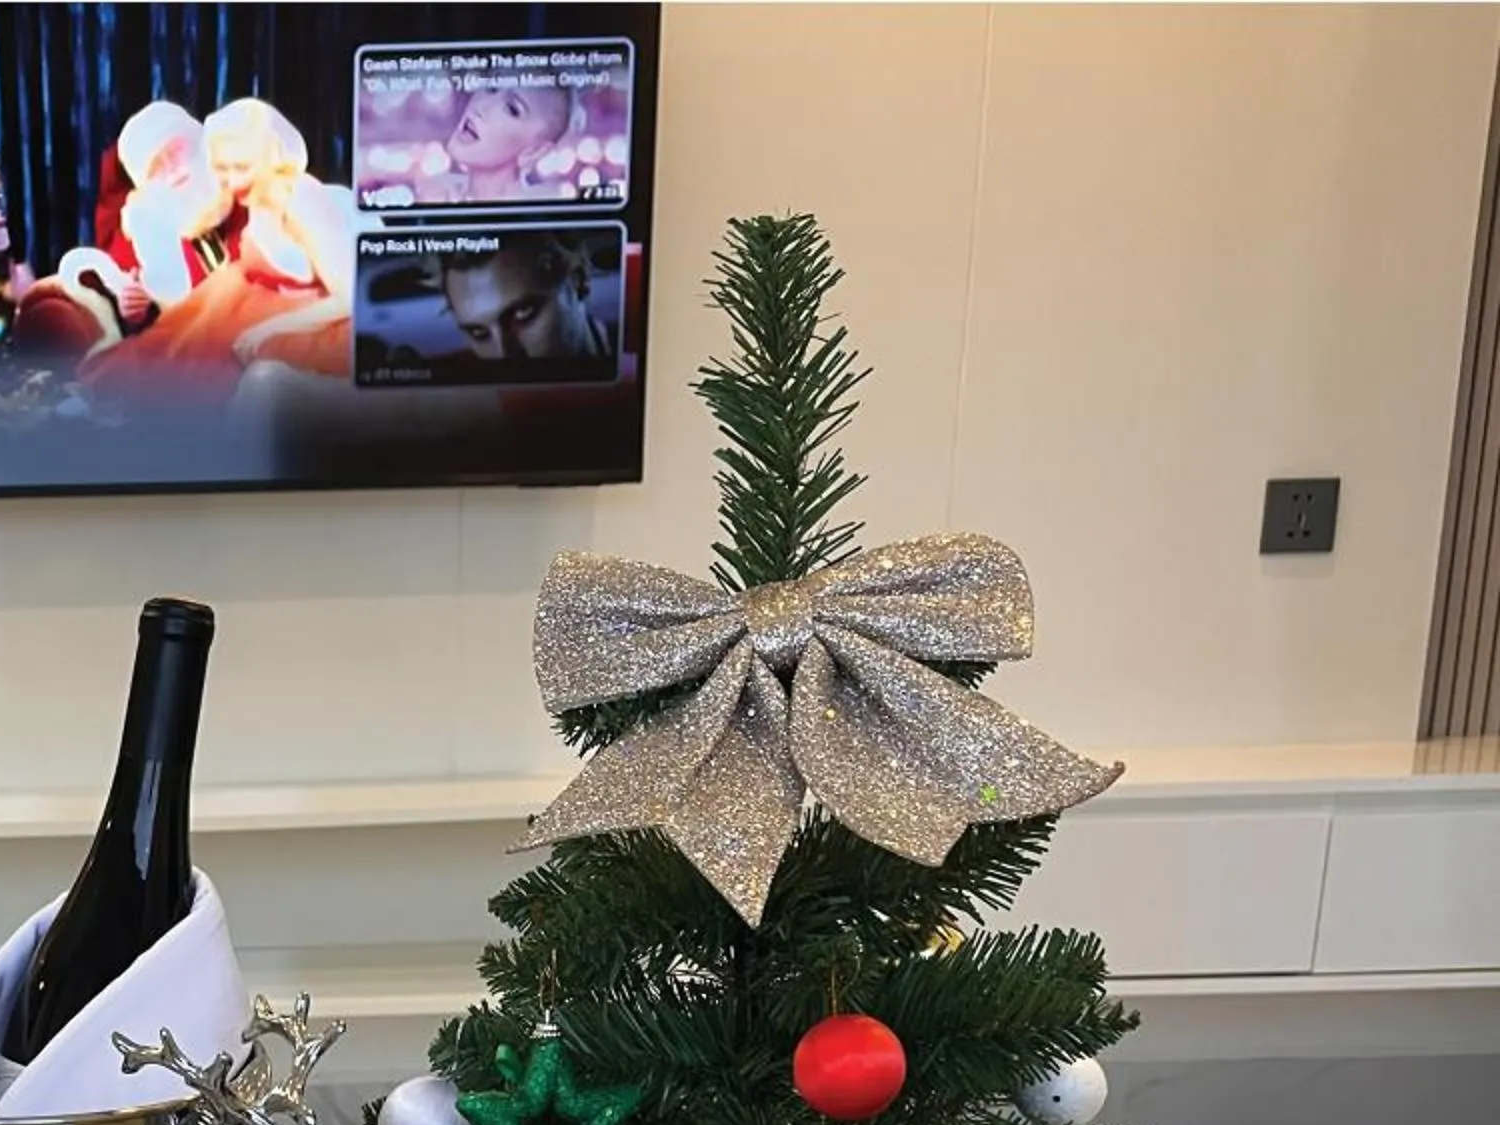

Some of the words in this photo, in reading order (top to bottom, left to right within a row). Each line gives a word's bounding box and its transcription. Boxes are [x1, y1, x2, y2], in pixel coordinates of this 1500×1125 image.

[490, 54, 513, 68] The
[360, 239, 384, 255] Pop
[386, 239, 416, 252] Rock
